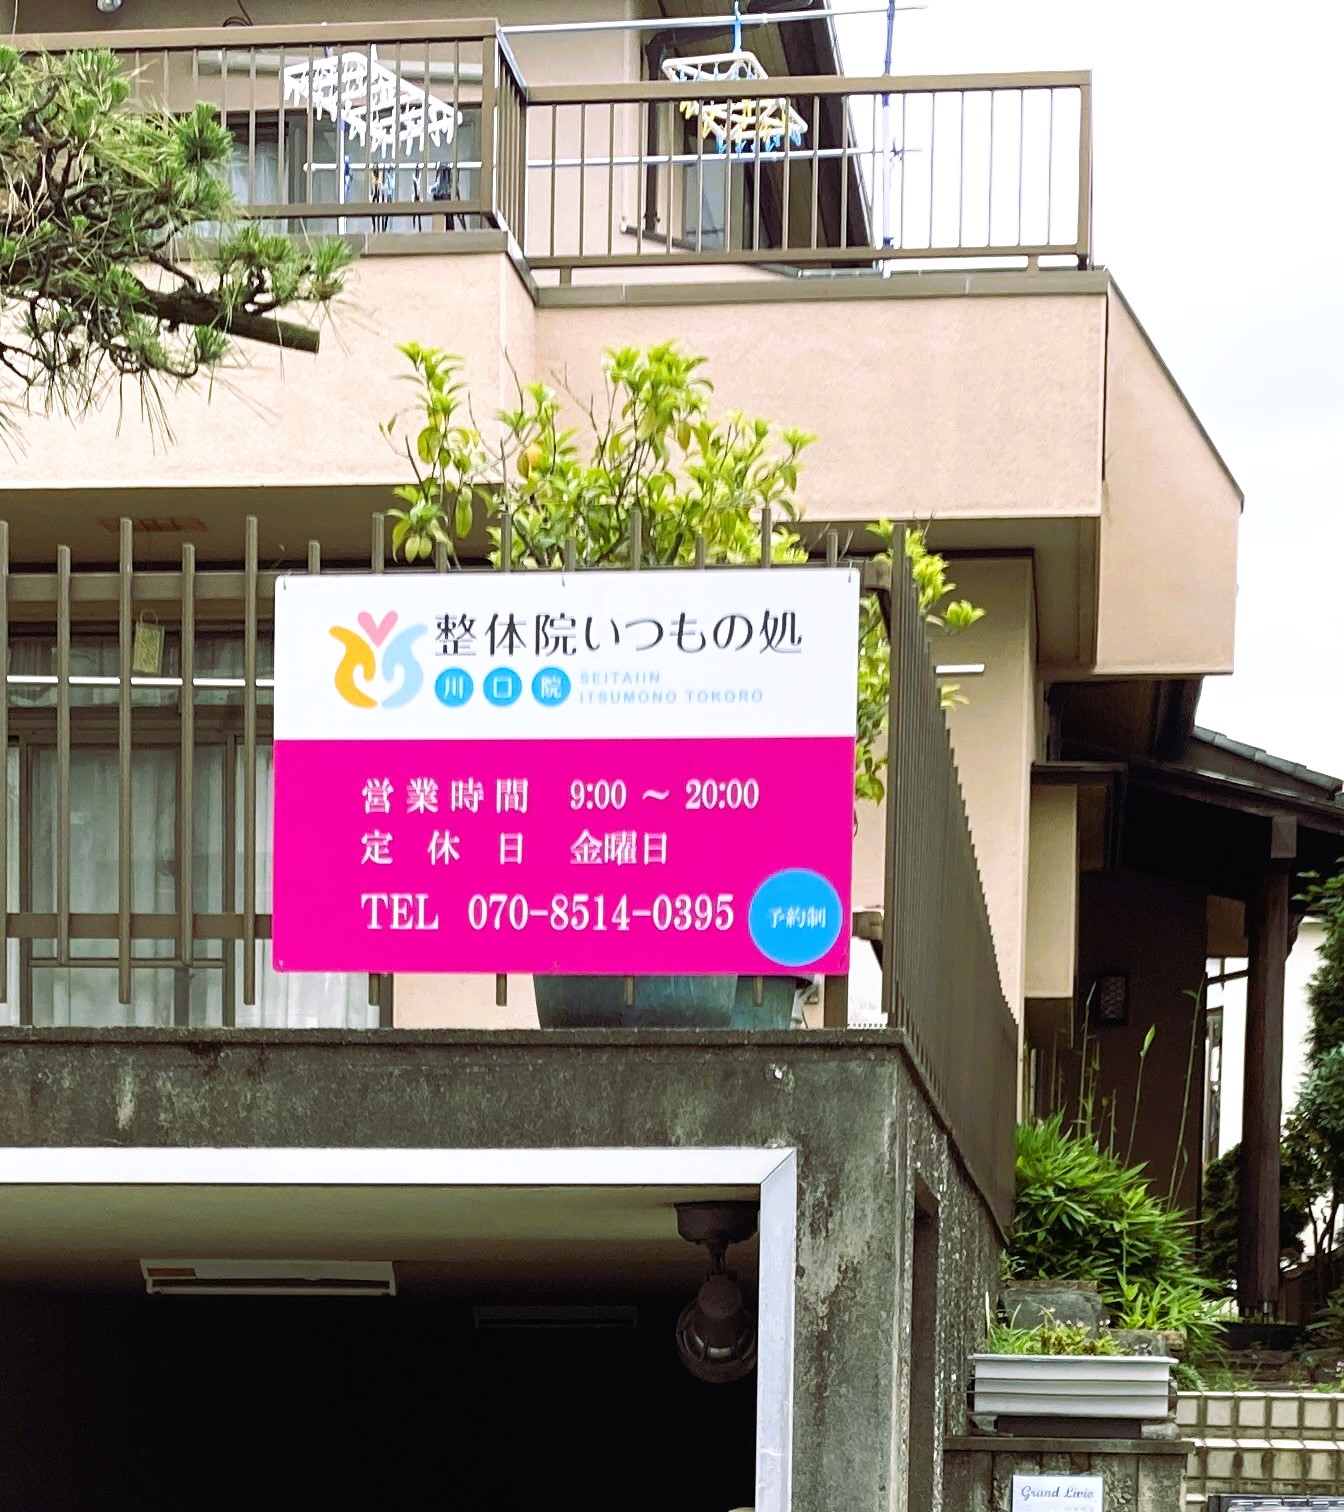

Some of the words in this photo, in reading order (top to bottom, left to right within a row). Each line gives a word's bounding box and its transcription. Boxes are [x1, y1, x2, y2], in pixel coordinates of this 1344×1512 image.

[434, 607, 803, 658] 整体院いつもの処
[442, 673, 564, 701] 川口院
[579, 671, 661, 685] SEITAIIN
[579, 689, 678, 704] ITSUMONO
[685, 688, 764, 704] TOKORO
[361, 776, 529, 814] 営業時間
[569, 777, 628, 810] 9:00
[684, 777, 759, 810] 20:00
[360, 829, 524, 866] 定休日
[569, 829, 668, 866] 金曜日
[360, 893, 440, 931] TEL
[467, 893, 735, 931] 070-8514-0395
[767, 906, 827, 929] 予約制
[1020, 1485, 1061, 1502] Grand
